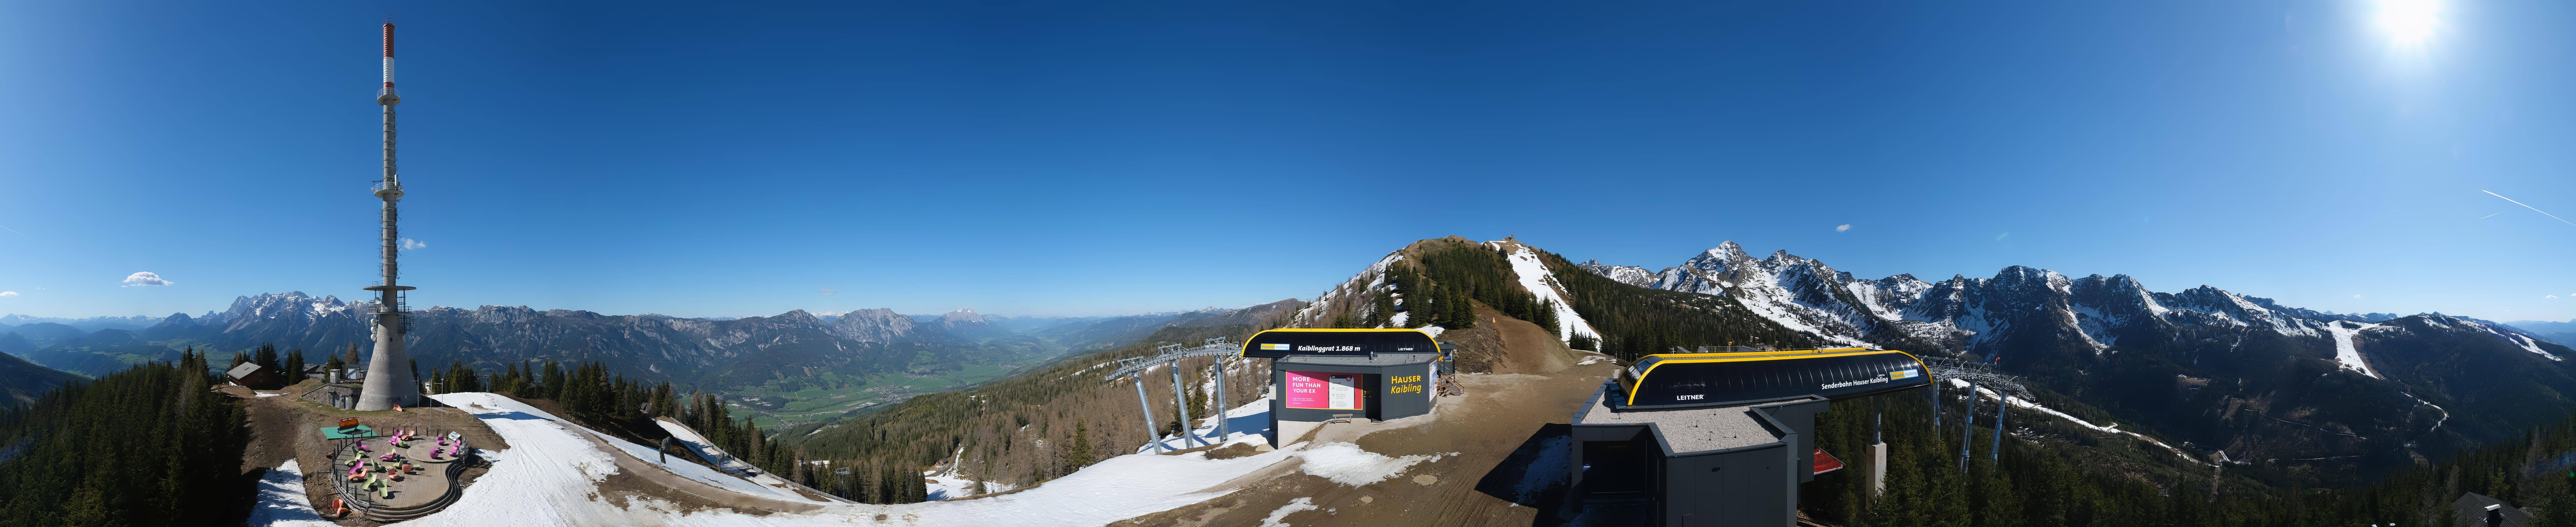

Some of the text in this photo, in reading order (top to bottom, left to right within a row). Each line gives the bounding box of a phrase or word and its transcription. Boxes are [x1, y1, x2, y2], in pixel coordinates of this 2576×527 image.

[1391, 375, 1421, 384] HAUSER
[1391, 384, 1421, 394] Kaibling
[1822, 381, 1852, 389] Senderbahn
